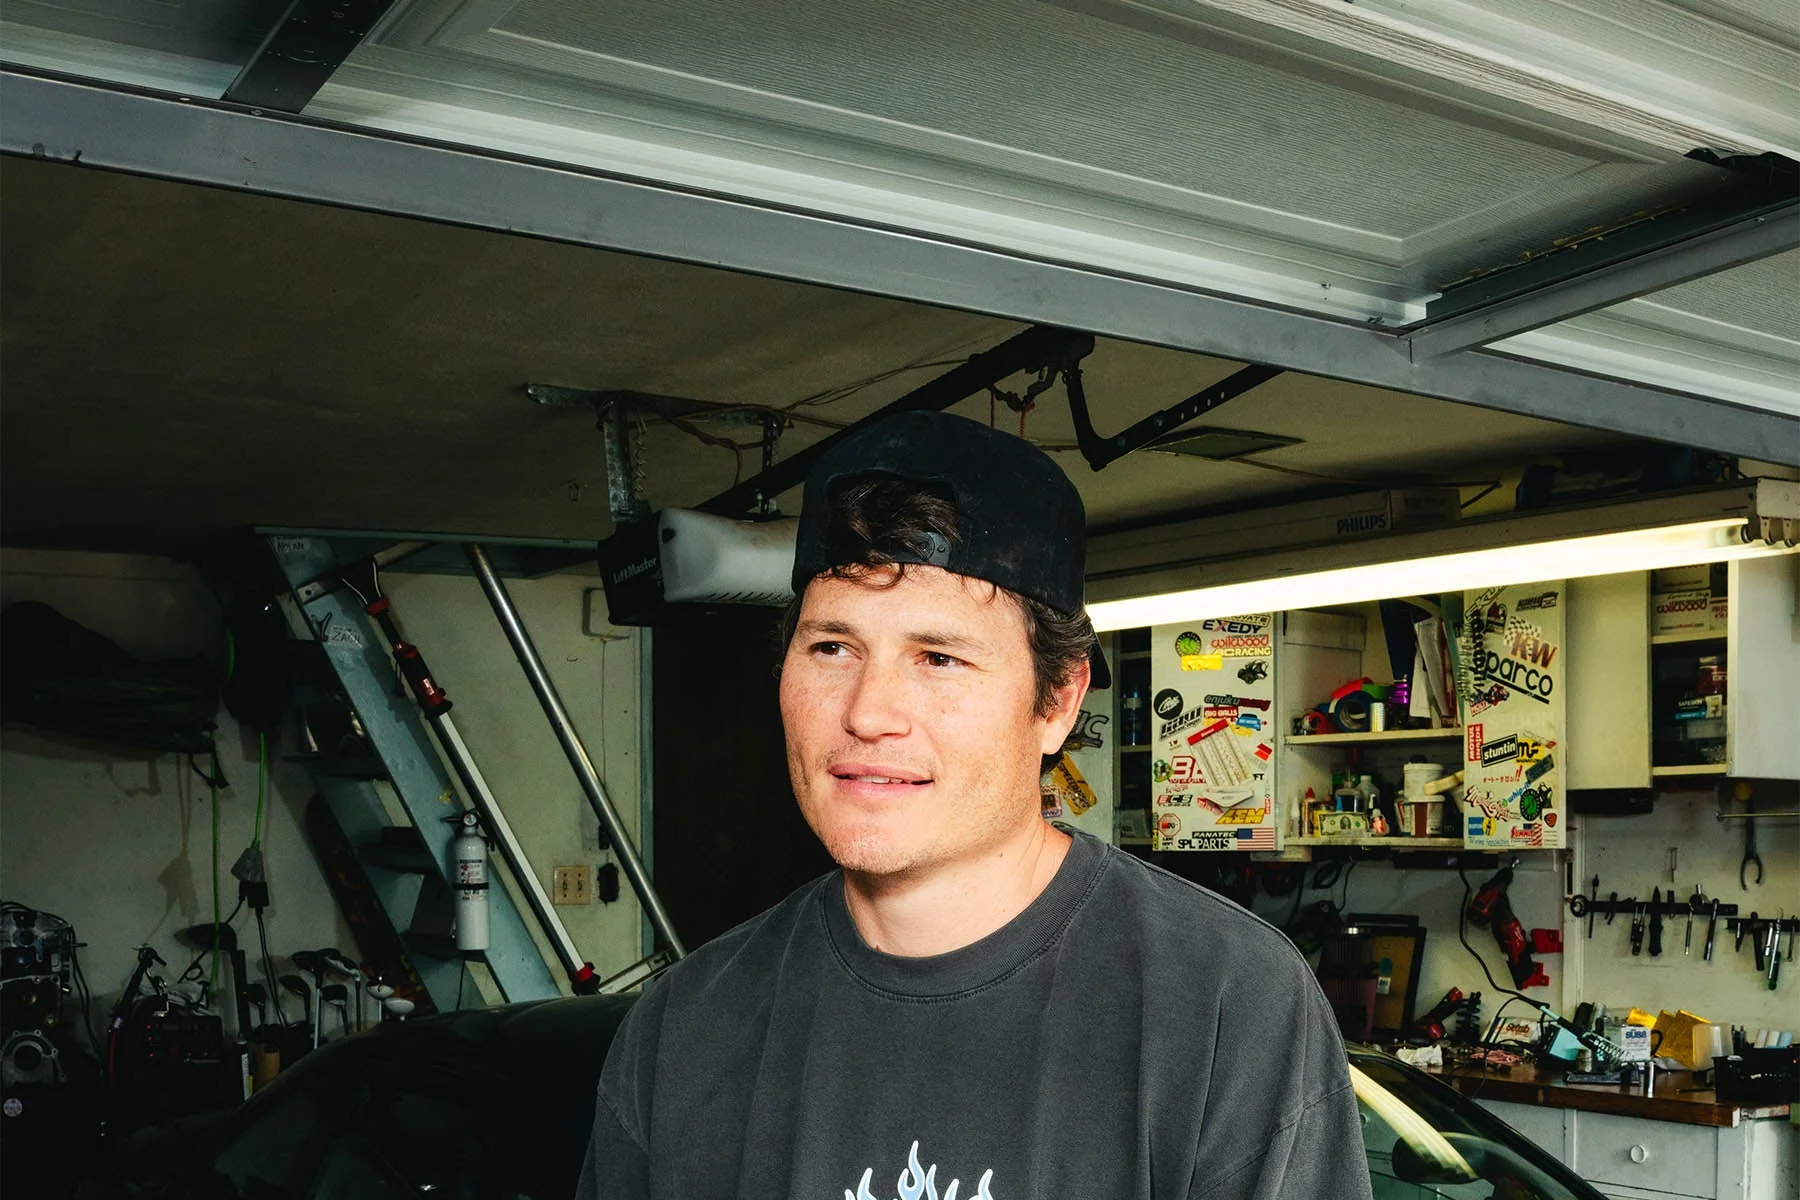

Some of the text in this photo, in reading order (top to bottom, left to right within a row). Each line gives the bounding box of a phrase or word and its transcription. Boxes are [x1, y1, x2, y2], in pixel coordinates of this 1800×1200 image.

[1336, 514, 1386, 534] PHILIPS
[1202, 619, 1263, 634] EXEDY
[1210, 634, 1269, 649] wilwood
[1510, 632, 1558, 670] KW
[1484, 650, 1553, 696] parco
[1483, 741, 1517, 760] stuntin
[1178, 838, 1196, 850] SPL
[1197, 838, 1231, 850] PARTS
